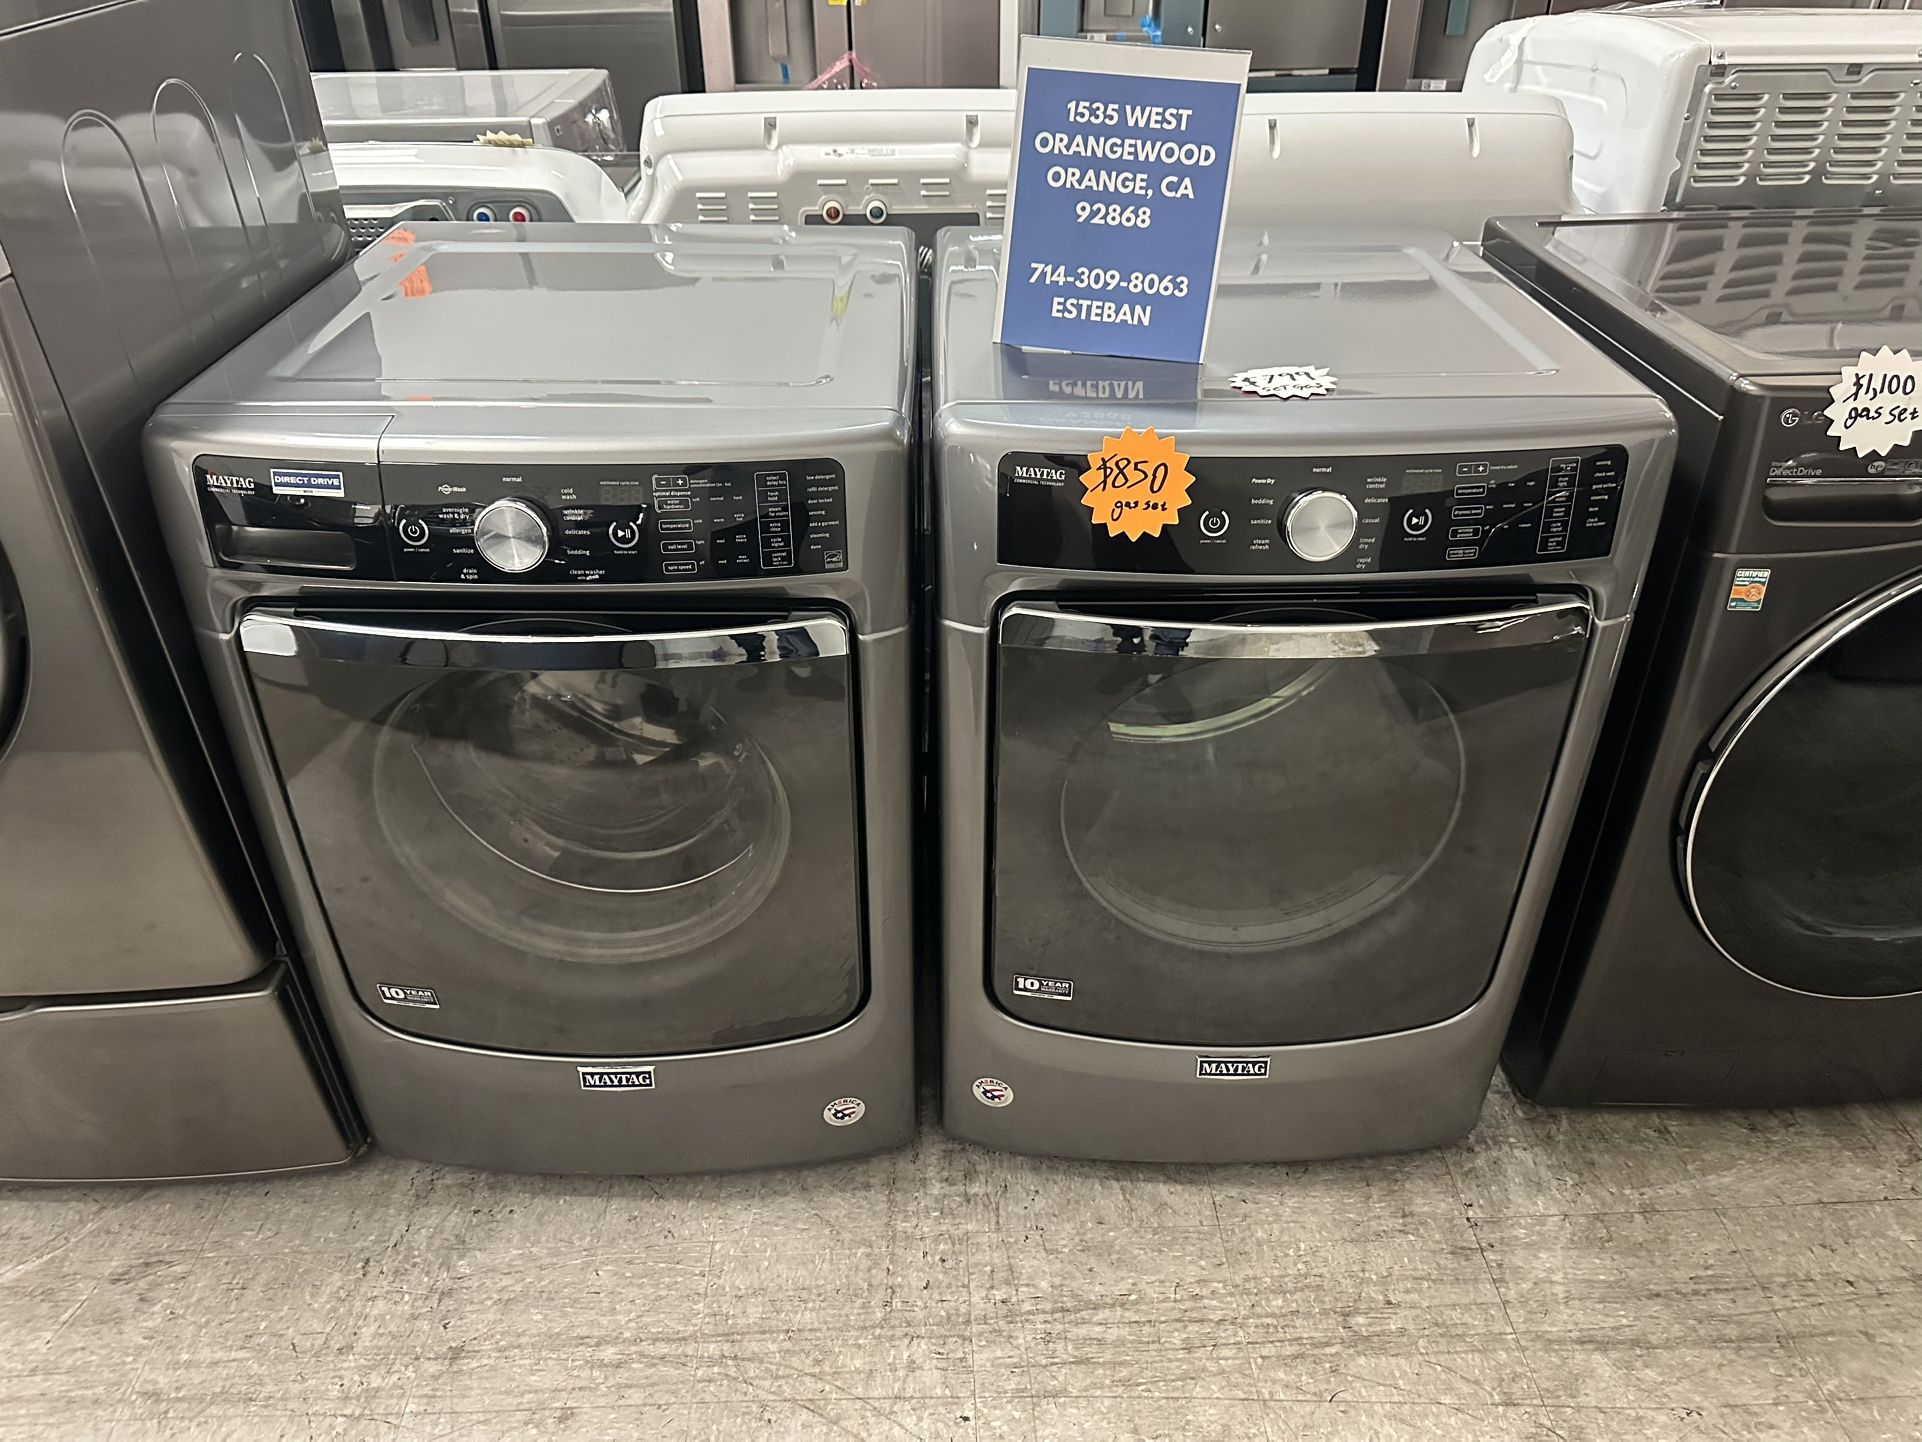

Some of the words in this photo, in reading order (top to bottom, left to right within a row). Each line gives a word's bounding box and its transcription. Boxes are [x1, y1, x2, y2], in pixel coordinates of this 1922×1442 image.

[1067, 101, 1118, 126] 1535
[1125, 105, 1192, 131] WEST
[1035, 132, 1215, 167] ORANGEWOOD
[1047, 167, 1153, 199] ORANGE,
[1161, 177, 1195, 199] CA
[1075, 202, 1151, 228] 92868
[1028, 262, 1189, 297] 714-309-8063
[1051, 297, 1151, 326] ESTEBAN
[1843, 373, 1915, 403] $1,100
[1844, 406, 1883, 429] gas
[206, 474, 254, 488] MAYTAG
[275, 476, 308, 484] DIRECT
[1014, 466, 1065, 480] MAYTAG
[1090, 454, 1168, 494] $850
[1111, 501, 1139, 521] gas
[1143, 500, 1167, 511] set
[382, 987, 404, 998] 10
[1017, 978, 1039, 990] 10
[1201, 1063, 1265, 1073] MAYTAG
[585, 1074, 650, 1085] MAYTAG
[976, 1080, 1008, 1091] AMERICA
